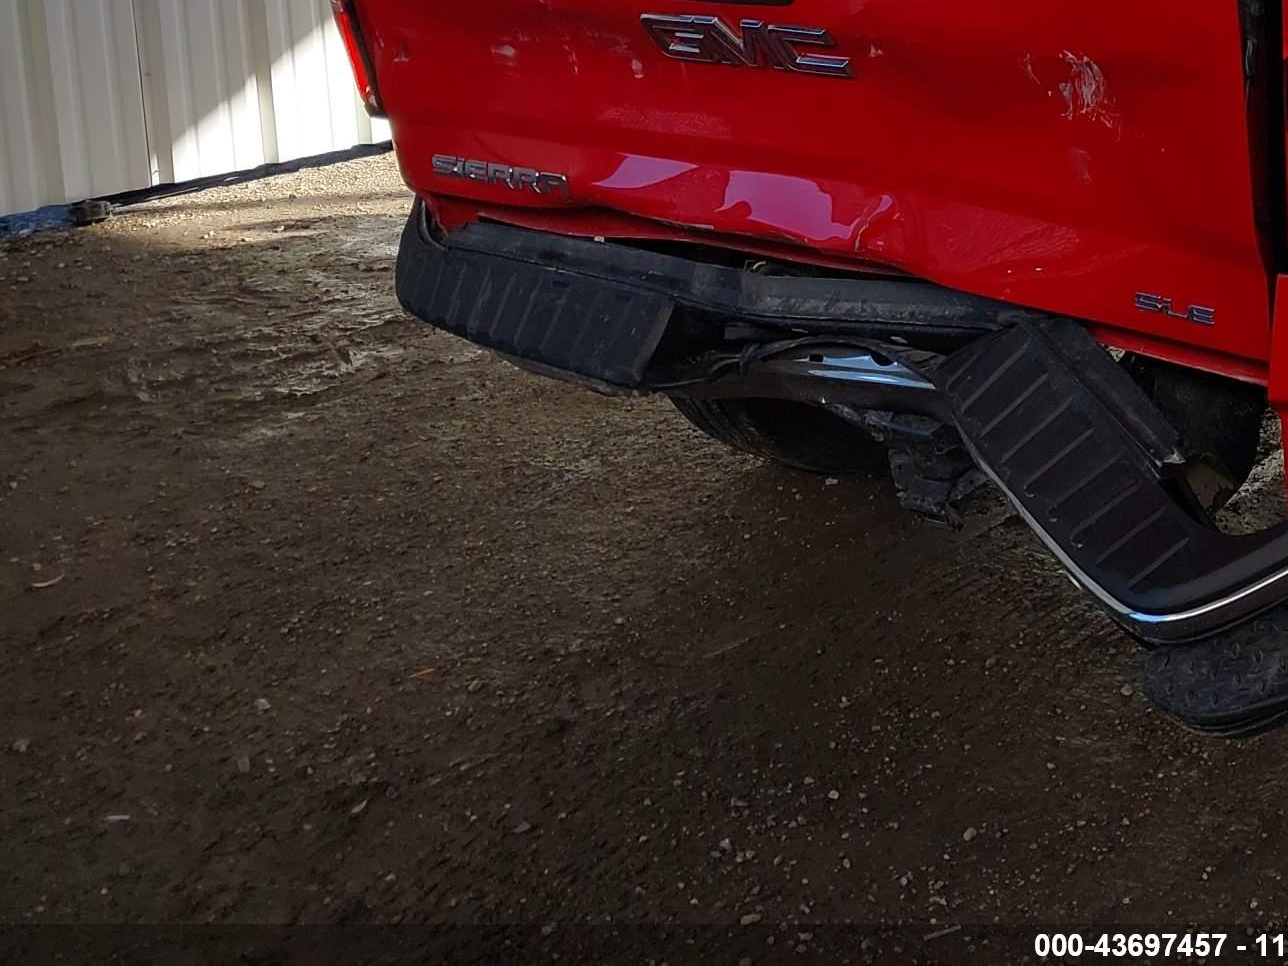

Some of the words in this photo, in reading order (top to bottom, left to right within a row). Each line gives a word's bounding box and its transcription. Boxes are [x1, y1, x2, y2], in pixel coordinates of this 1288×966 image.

[640, 13, 857, 77] GMC
[431, 153, 572, 202] SIERRA
[1134, 291, 1215, 326] SLE
